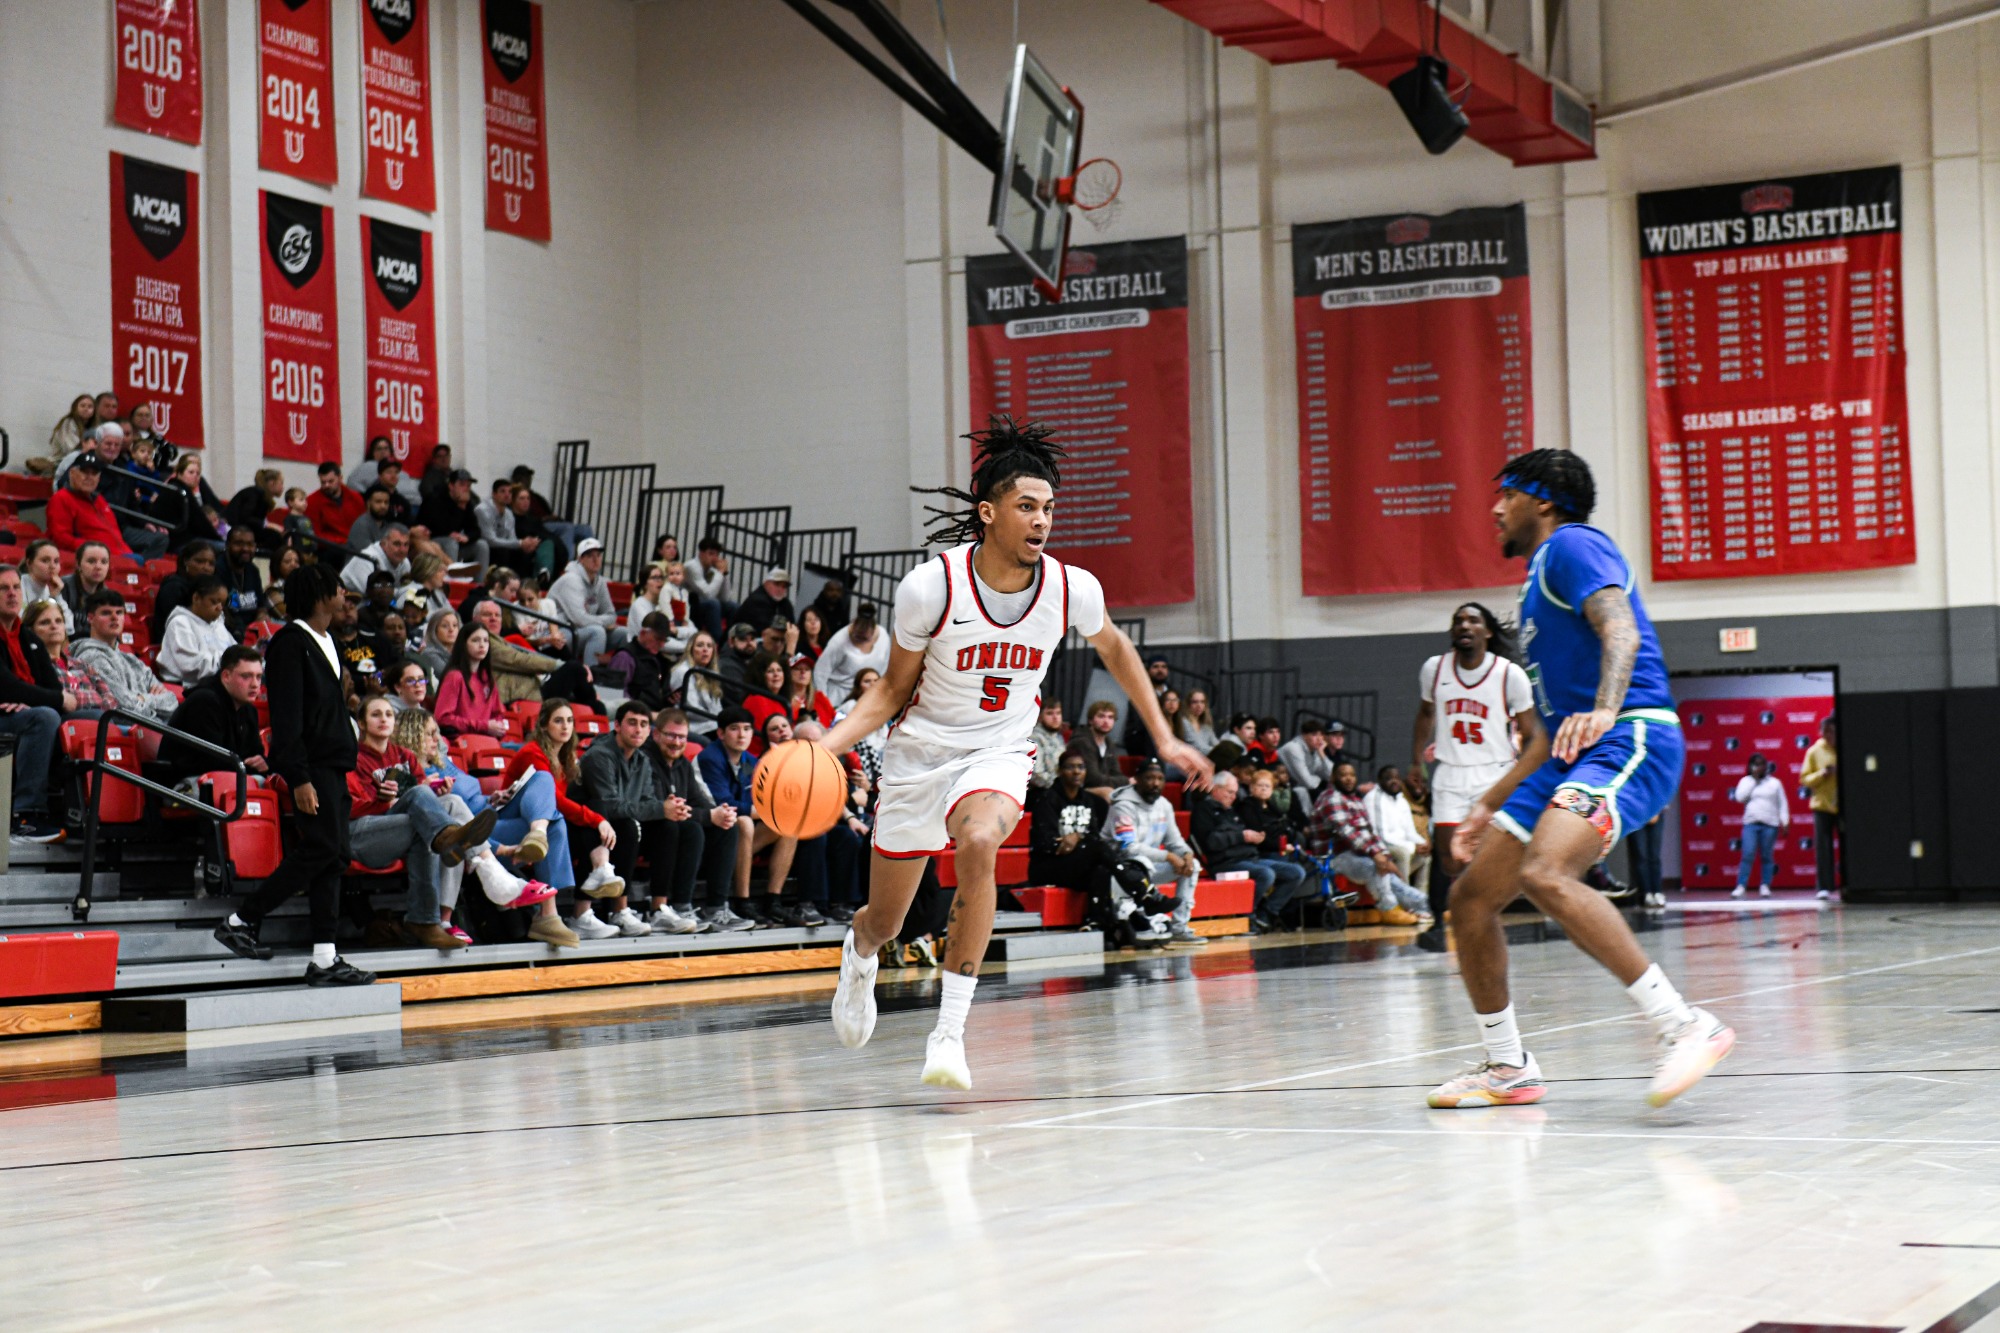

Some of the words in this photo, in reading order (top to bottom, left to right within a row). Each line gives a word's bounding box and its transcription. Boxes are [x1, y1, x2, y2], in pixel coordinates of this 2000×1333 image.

[124, 24, 183, 82] 2016
[265, 22, 320, 56] CHAMPIONS
[492, 30, 528, 60] NCAA
[372, 47, 415, 77] NATIONAL
[365, 64, 421, 99] TOURNAMENT
[267, 74, 320, 129] 2014
[369, 107, 419, 158] 2014
[489, 144, 535, 191] 2015
[133, 193, 181, 227] NCAA
[1644, 218, 1747, 253] WOMEN'S
[1752, 202, 1897, 242] BASKETBALL
[376, 255, 417, 285] NCAA
[1315, 251, 1373, 280] MEN'S
[1378, 240, 1508, 275] BASKETBALL
[1694, 261, 1719, 278] TOP
[1723, 259, 1737, 275] 10
[1740, 253, 1780, 273] FINAL
[1784, 246, 1848, 268] RANKING
[136, 275, 181, 305] HIGHEST
[987, 283, 1041, 311] MEN'S
[1046, 271, 1166, 304] ASKETBALL
[133, 299, 163, 323] TEAM
[164, 304, 184, 328] GPA
[269, 303, 324, 333] CHAMPIONS
[380, 317, 417, 342] HIGHEST
[1014, 317, 1068, 336] CONFERENCE
[1069, 311, 1141, 331] CHAMPIONSHIPS
[378, 338, 402, 360] TEAM
[129, 342, 189, 396] 2017
[271, 358, 324, 408] 2016
[376, 378, 423, 425] 2016
[1683, 411, 1734, 431] SEASON
[1738, 406, 1797, 427] RECORDS
[956, 641, 1044, 671] UNION
[979, 676, 1013, 712] 5
[1444, 698, 1489, 720] UNION
[1452, 720, 1484, 745] 45
